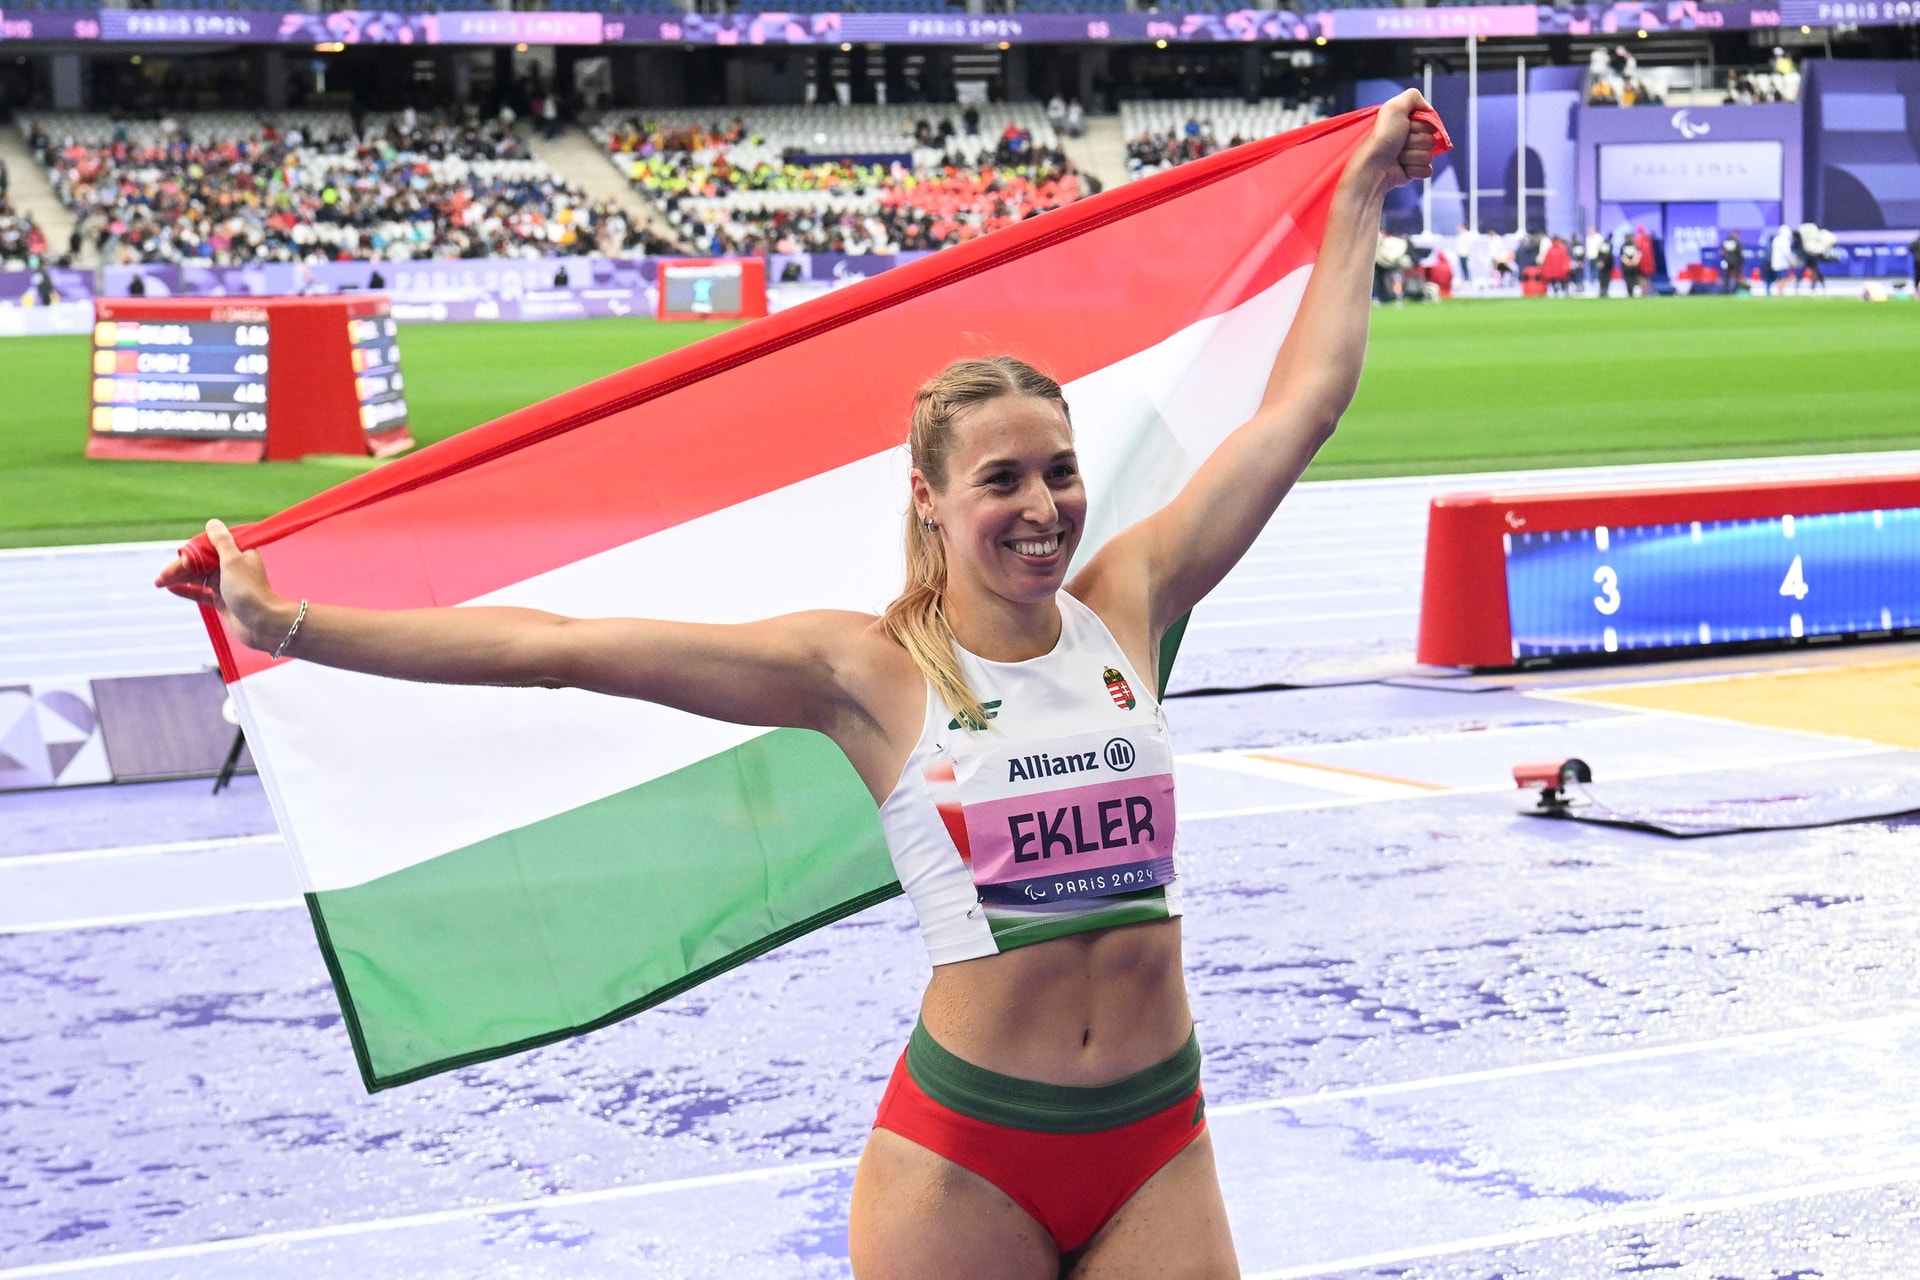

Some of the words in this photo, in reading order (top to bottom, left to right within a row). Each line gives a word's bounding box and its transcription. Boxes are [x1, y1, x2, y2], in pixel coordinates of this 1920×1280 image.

[1818, 2, 1878, 20] PARIS
[127, 16, 191, 34] PARIS
[193, 16, 251, 35] 2024
[460, 18, 518, 35] PARIS
[908, 19, 966, 37] PARIS
[968, 19, 1023, 37] 2024
[1376, 14, 1433, 32] PARIS
[1632, 162, 1689, 177] PARIS
[1778, 554, 1808, 600] 4
[1593, 565, 1621, 614] 3
[1008, 750, 1099, 783] Allianz
[1007, 796, 1155, 863] EKLER
[1054, 876, 1106, 895] PARIS
[1112, 869, 1153, 886] 2024
